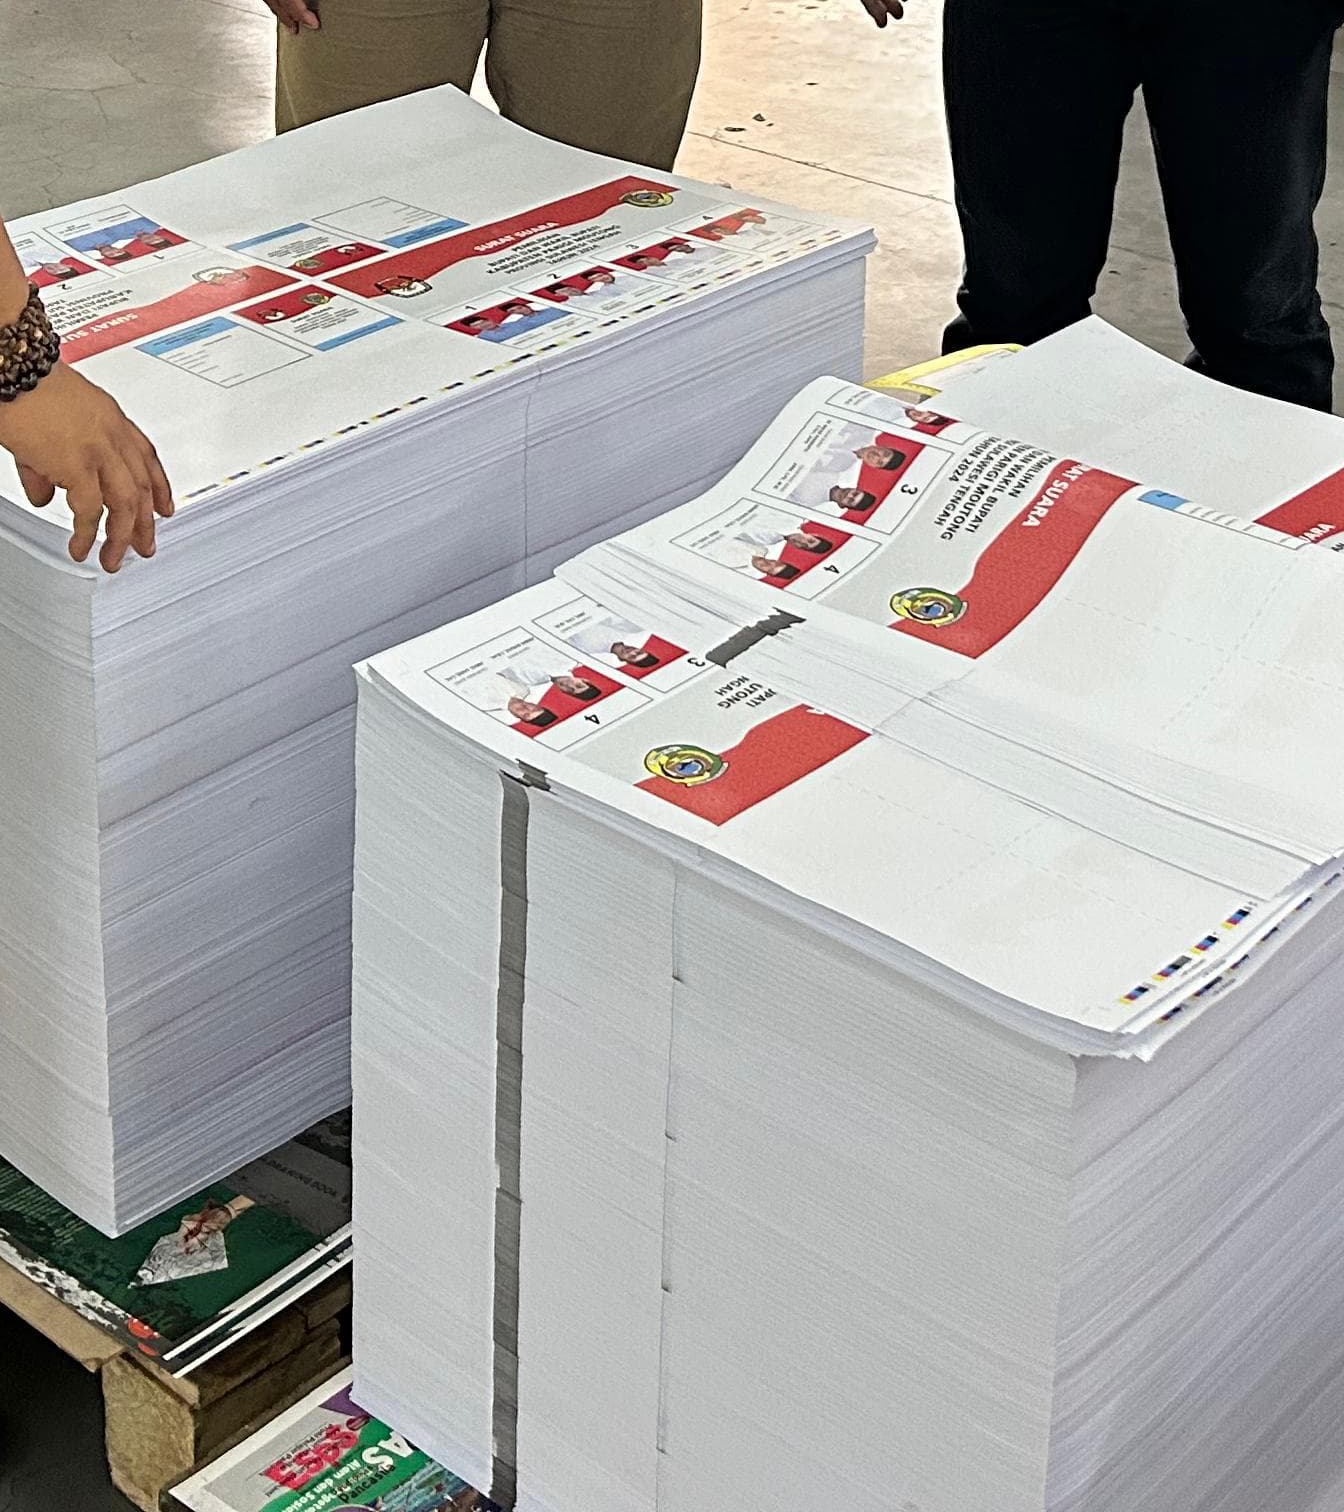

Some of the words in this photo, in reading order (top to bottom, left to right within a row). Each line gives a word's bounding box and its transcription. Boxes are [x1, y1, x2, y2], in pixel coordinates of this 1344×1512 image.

[473, 234, 516, 252] SURAT
[515, 221, 561, 239] SUARA
[90, 311, 139, 334] SURAT
[948, 461, 970, 484] 2024
[900, 483, 919, 496] 3
[933, 485, 972, 527] TENGAH
[940, 484, 989, 542] MOUTONG
[1022, 478, 1070, 528] SUARA
[967, 496, 998, 534] BUPATI
[824, 564, 840, 574] 4
[687, 657, 706, 668] 3
[713, 675, 751, 697] NGAH
[716, 682, 764, 710] UTONG
[584, 714, 601, 725] 4
